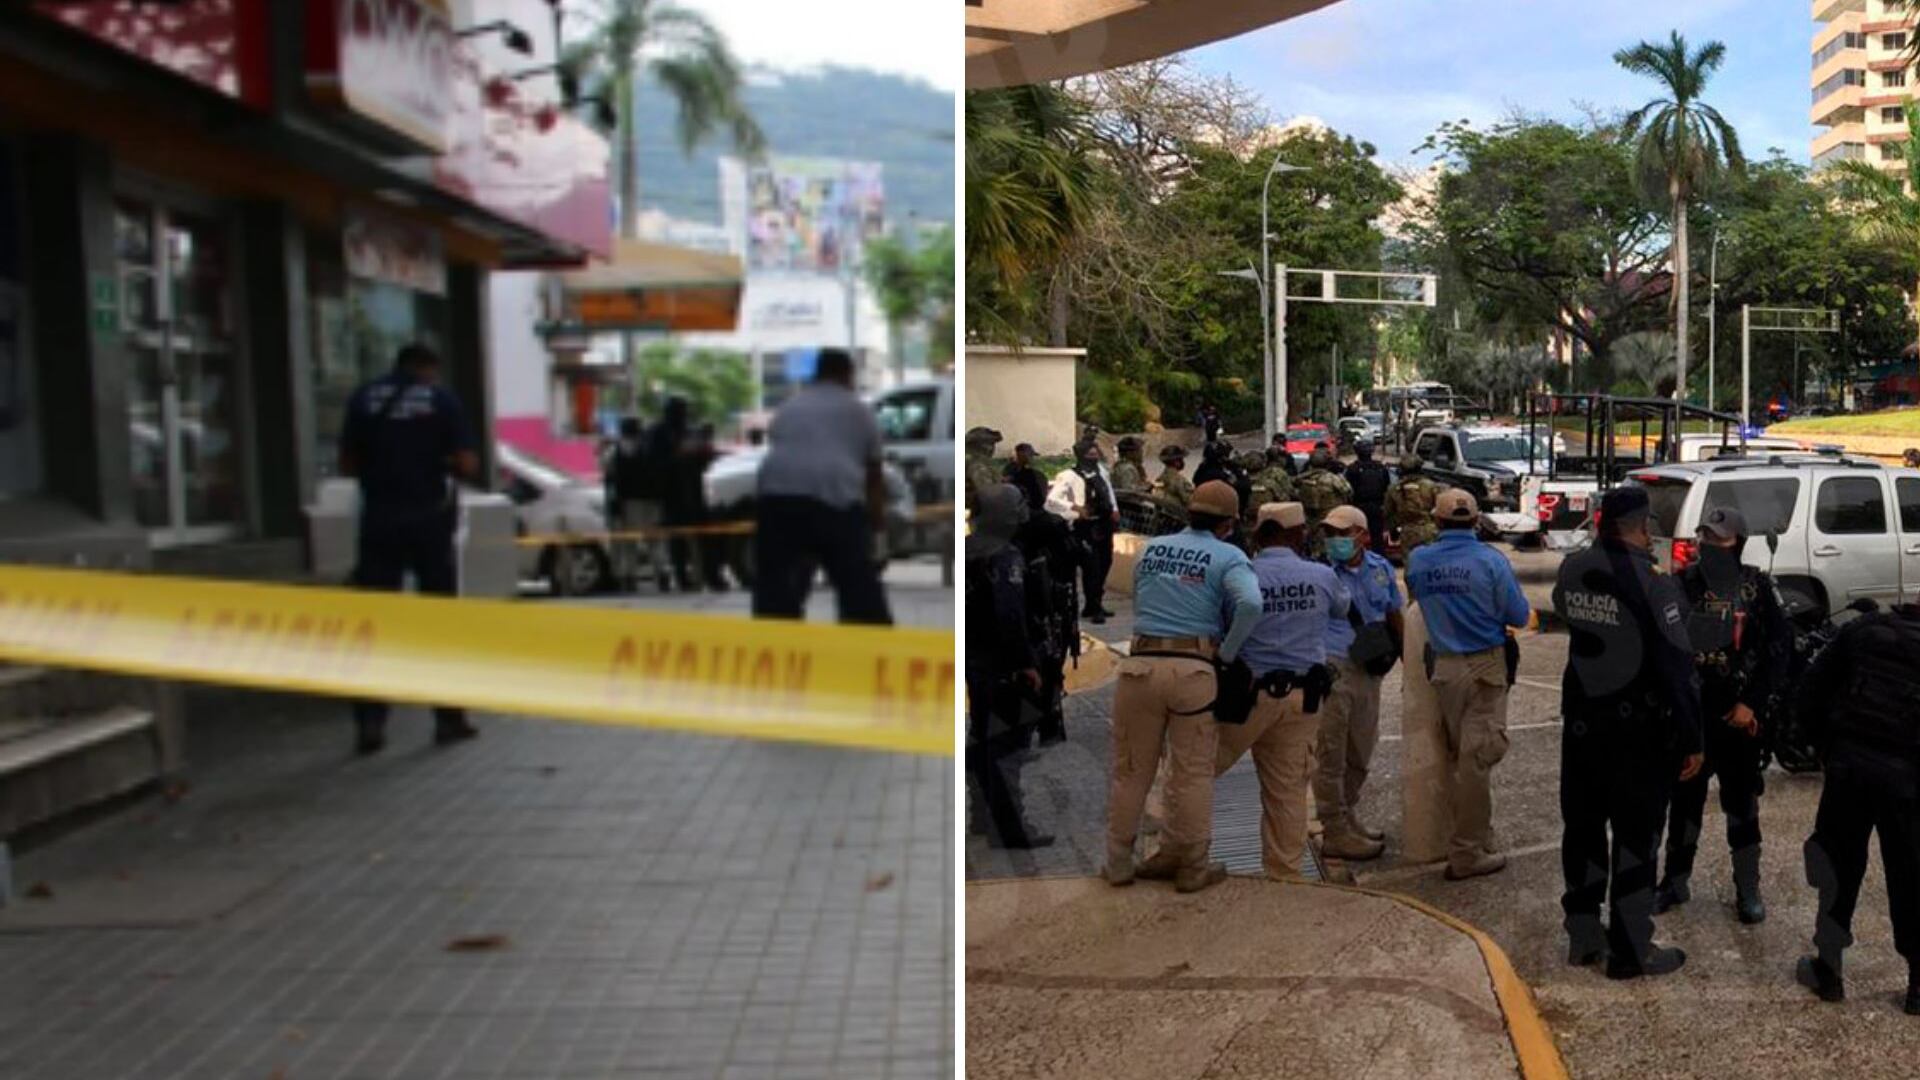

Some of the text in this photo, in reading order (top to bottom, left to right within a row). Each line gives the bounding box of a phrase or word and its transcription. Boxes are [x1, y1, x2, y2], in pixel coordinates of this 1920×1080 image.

[1143, 545, 1212, 565] POLICÍA
[1260, 581, 1316, 600] OLICÍA
[1564, 591, 1619, 612] POLICÍA
